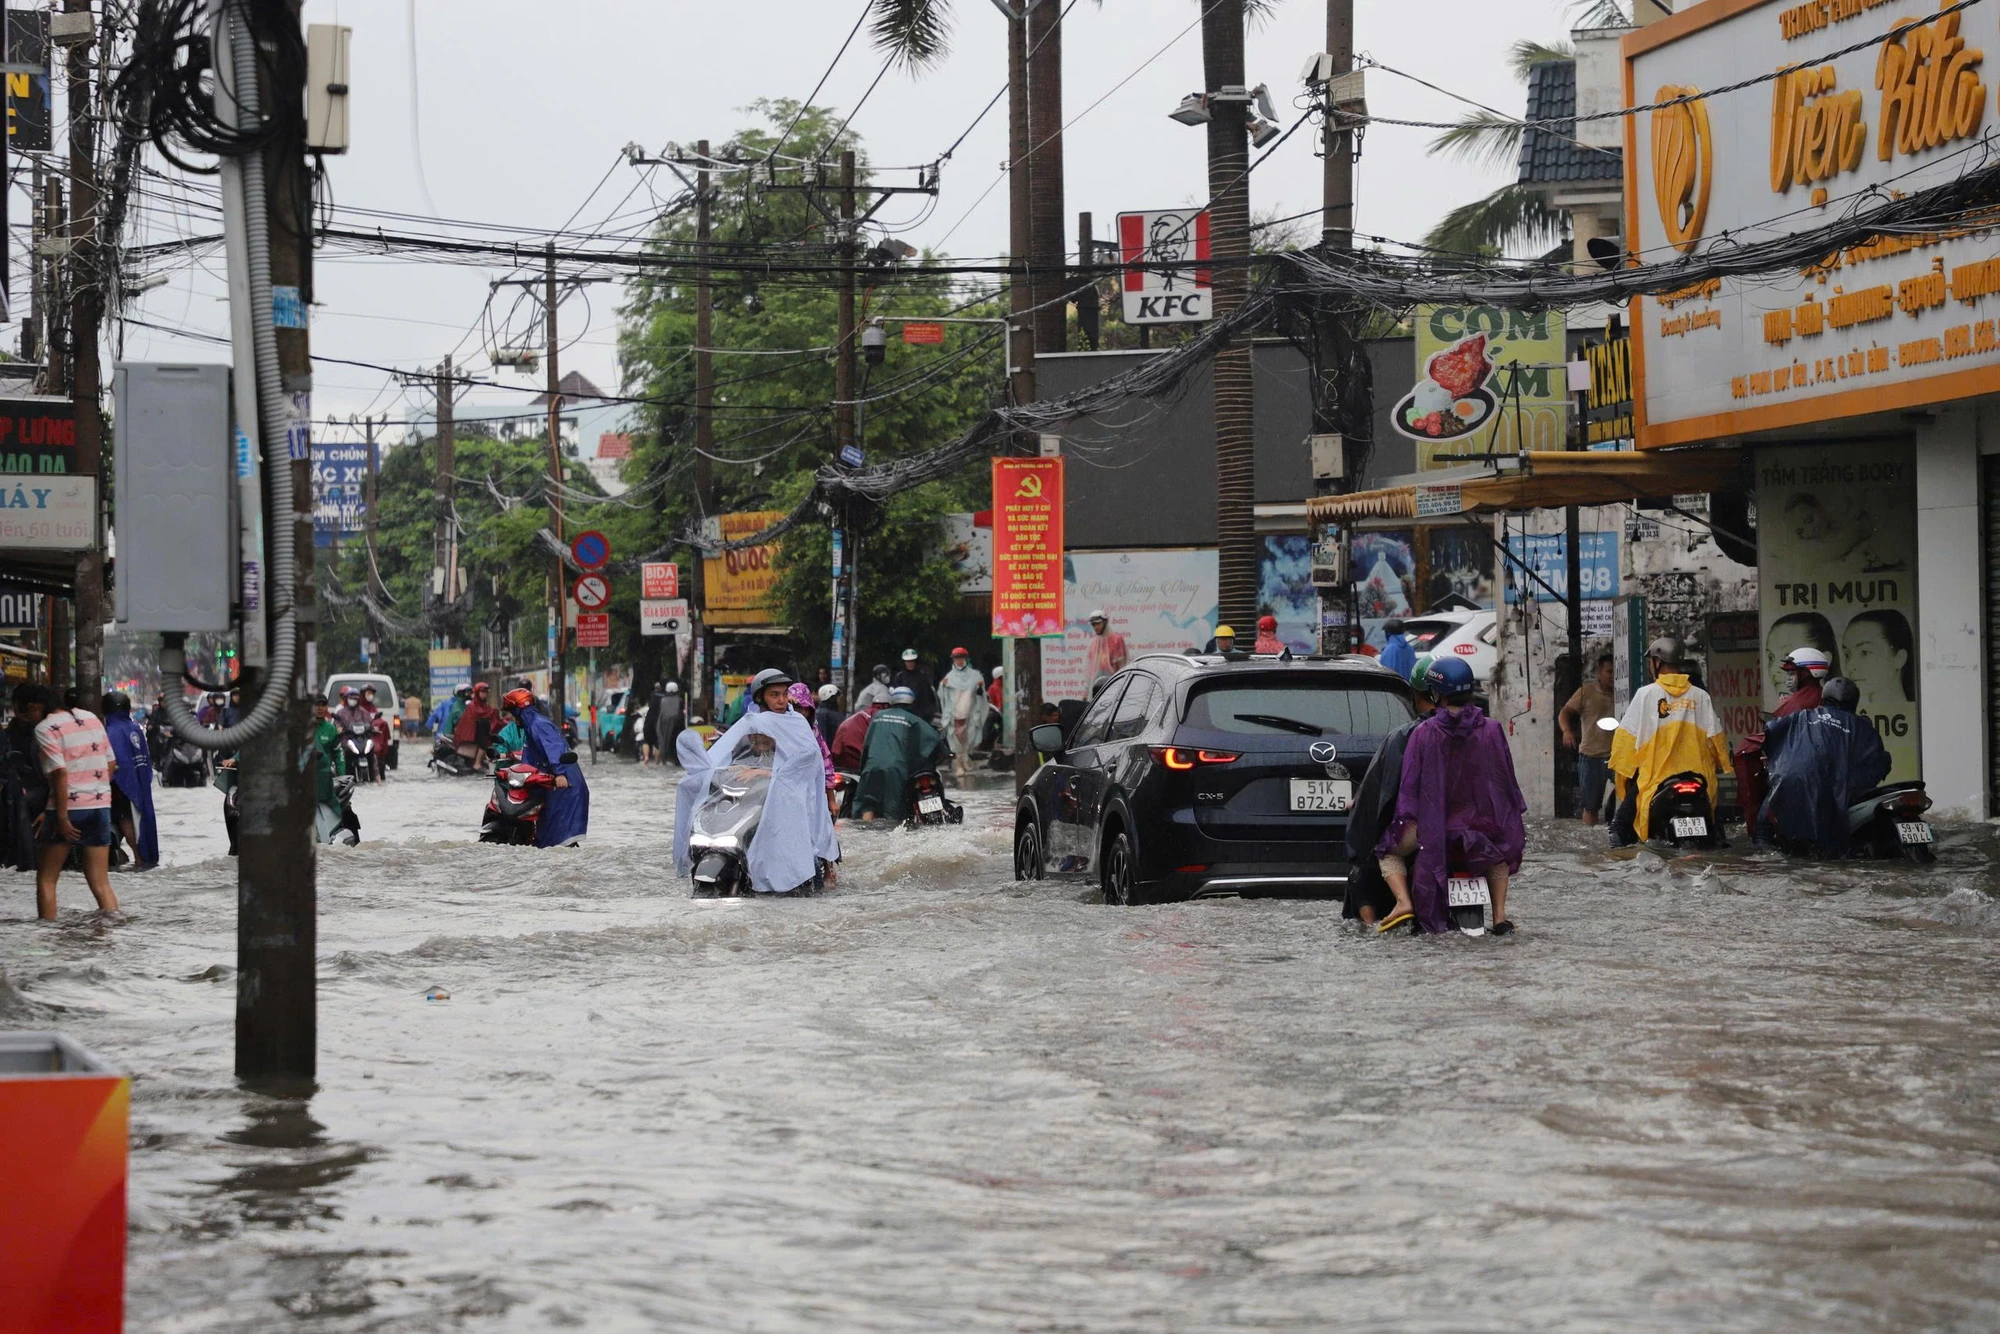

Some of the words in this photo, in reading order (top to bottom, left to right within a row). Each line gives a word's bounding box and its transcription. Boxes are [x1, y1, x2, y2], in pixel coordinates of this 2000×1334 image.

[1875, 0, 1987, 162] Rita
[1136, 294, 1201, 318] KFC
[39, 453, 67, 473] DA
[0, 482, 52, 508] ÁY
[1005, 503, 1020, 512] PHÁT
[1022, 504, 1033, 512] HUY
[1007, 514, 1016, 522] VÀ
[1516, 539, 1559, 549] UBND
[1580, 550, 1607, 559] ÌNH
[645, 566, 675, 579] BIDA
[1580, 567, 1612, 593] 98
[1775, 582, 1817, 609] TRỊ
[1828, 579, 1898, 608] MỤN
[1308, 781, 1334, 794] 51K
[1198, 792, 1224, 800] CX-5
[1297, 796, 1346, 809] 872.45
[1450, 880, 1481, 891] 71-C1
